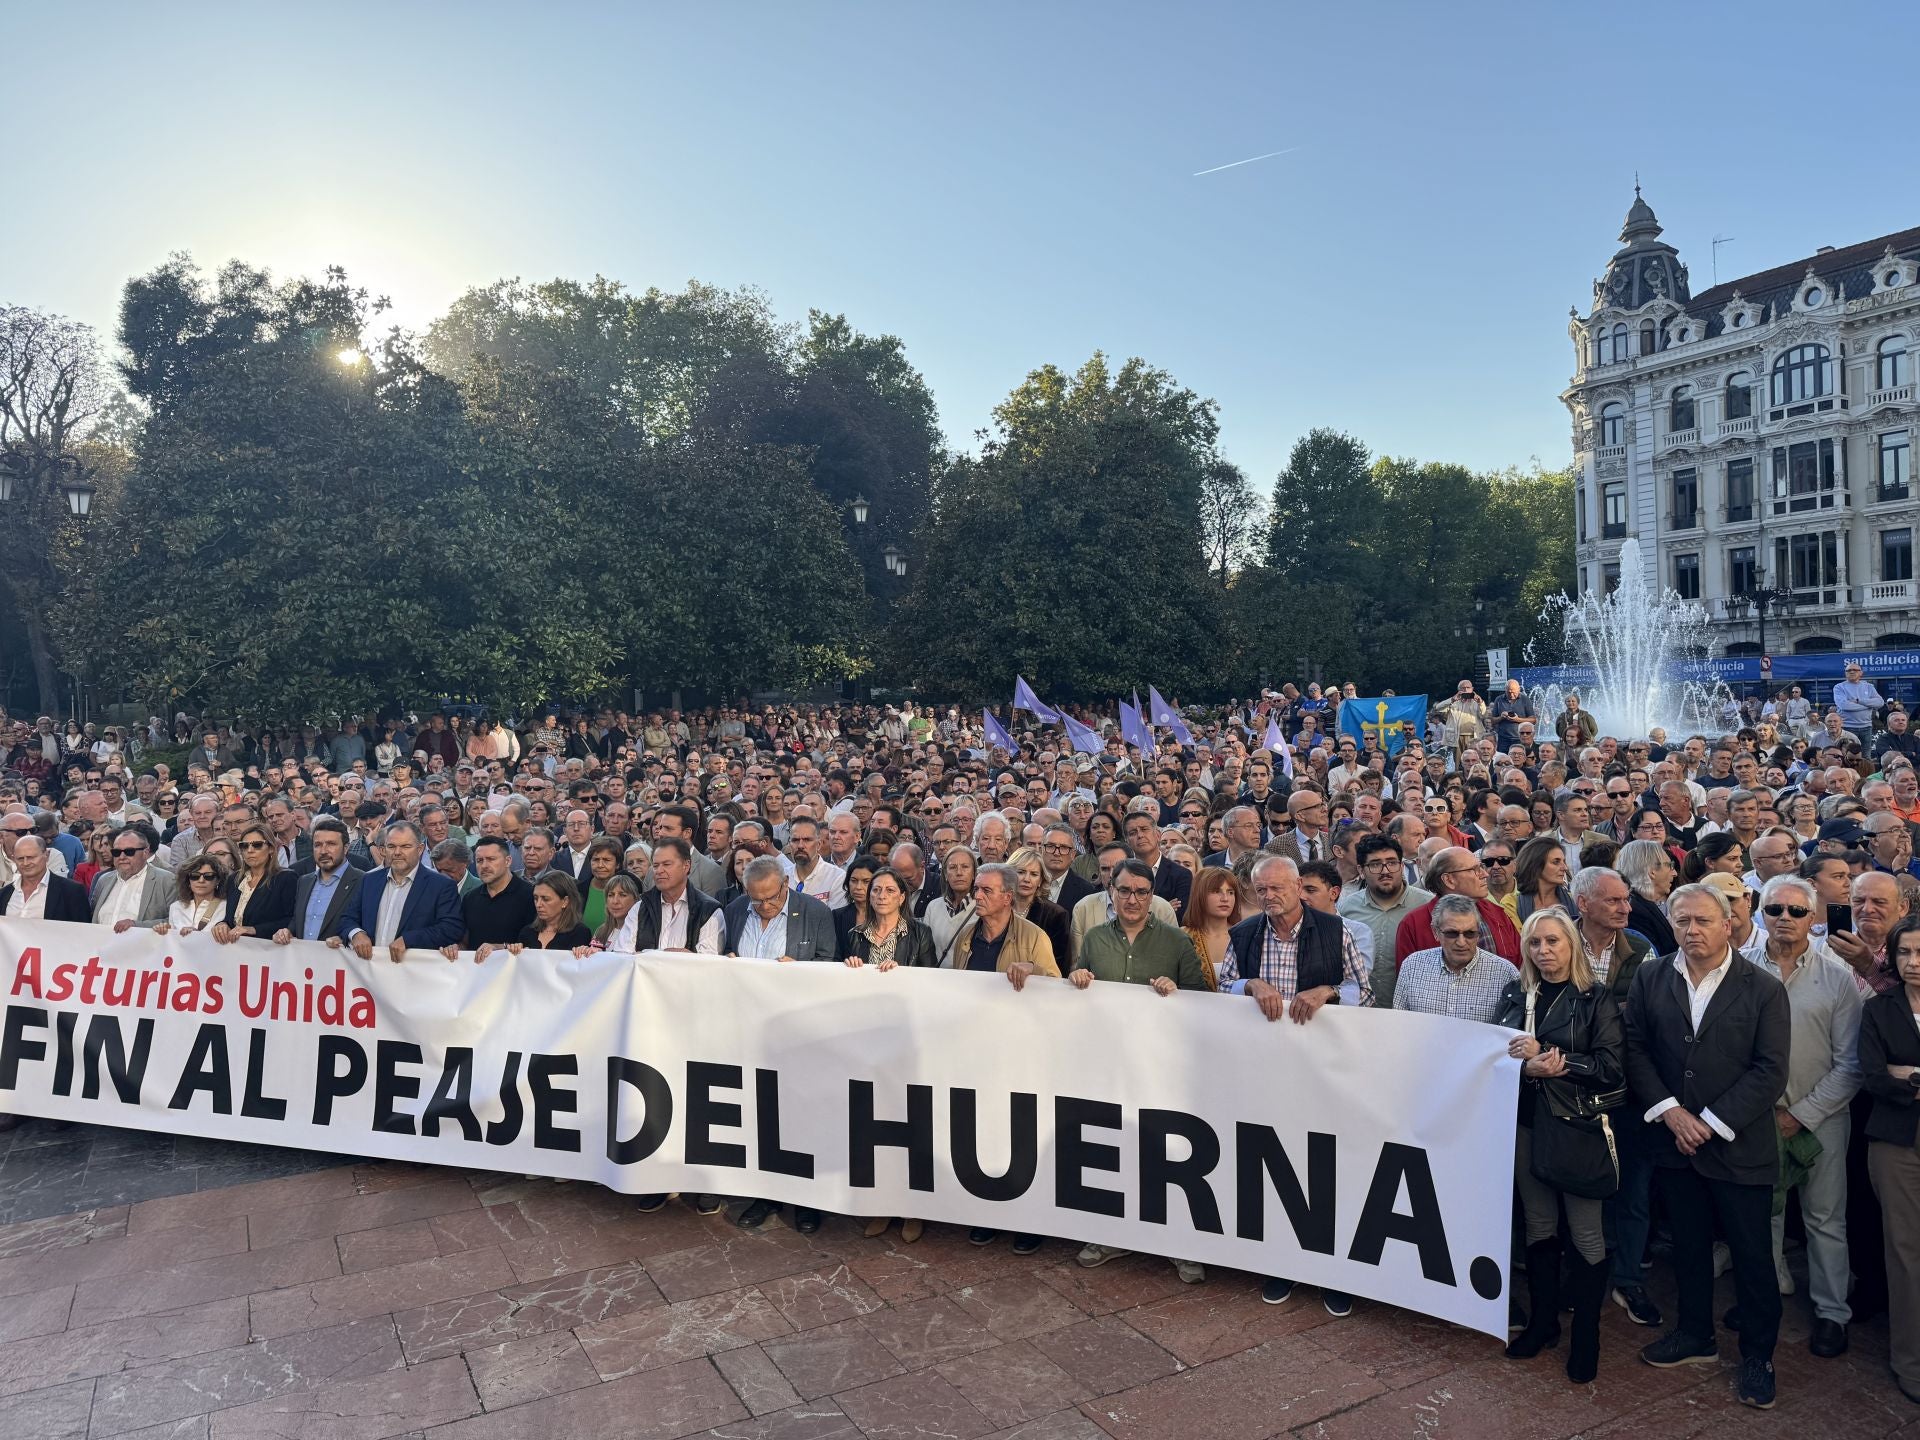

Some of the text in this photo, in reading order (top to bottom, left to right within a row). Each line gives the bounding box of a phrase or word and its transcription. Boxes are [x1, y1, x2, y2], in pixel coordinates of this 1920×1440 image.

[1843, 653, 1919, 667] santalucía
[11, 947, 376, 1028] Asturias Unida
[0, 1004, 1502, 1301] FIN AL PEAJE DEL HUERNA.
